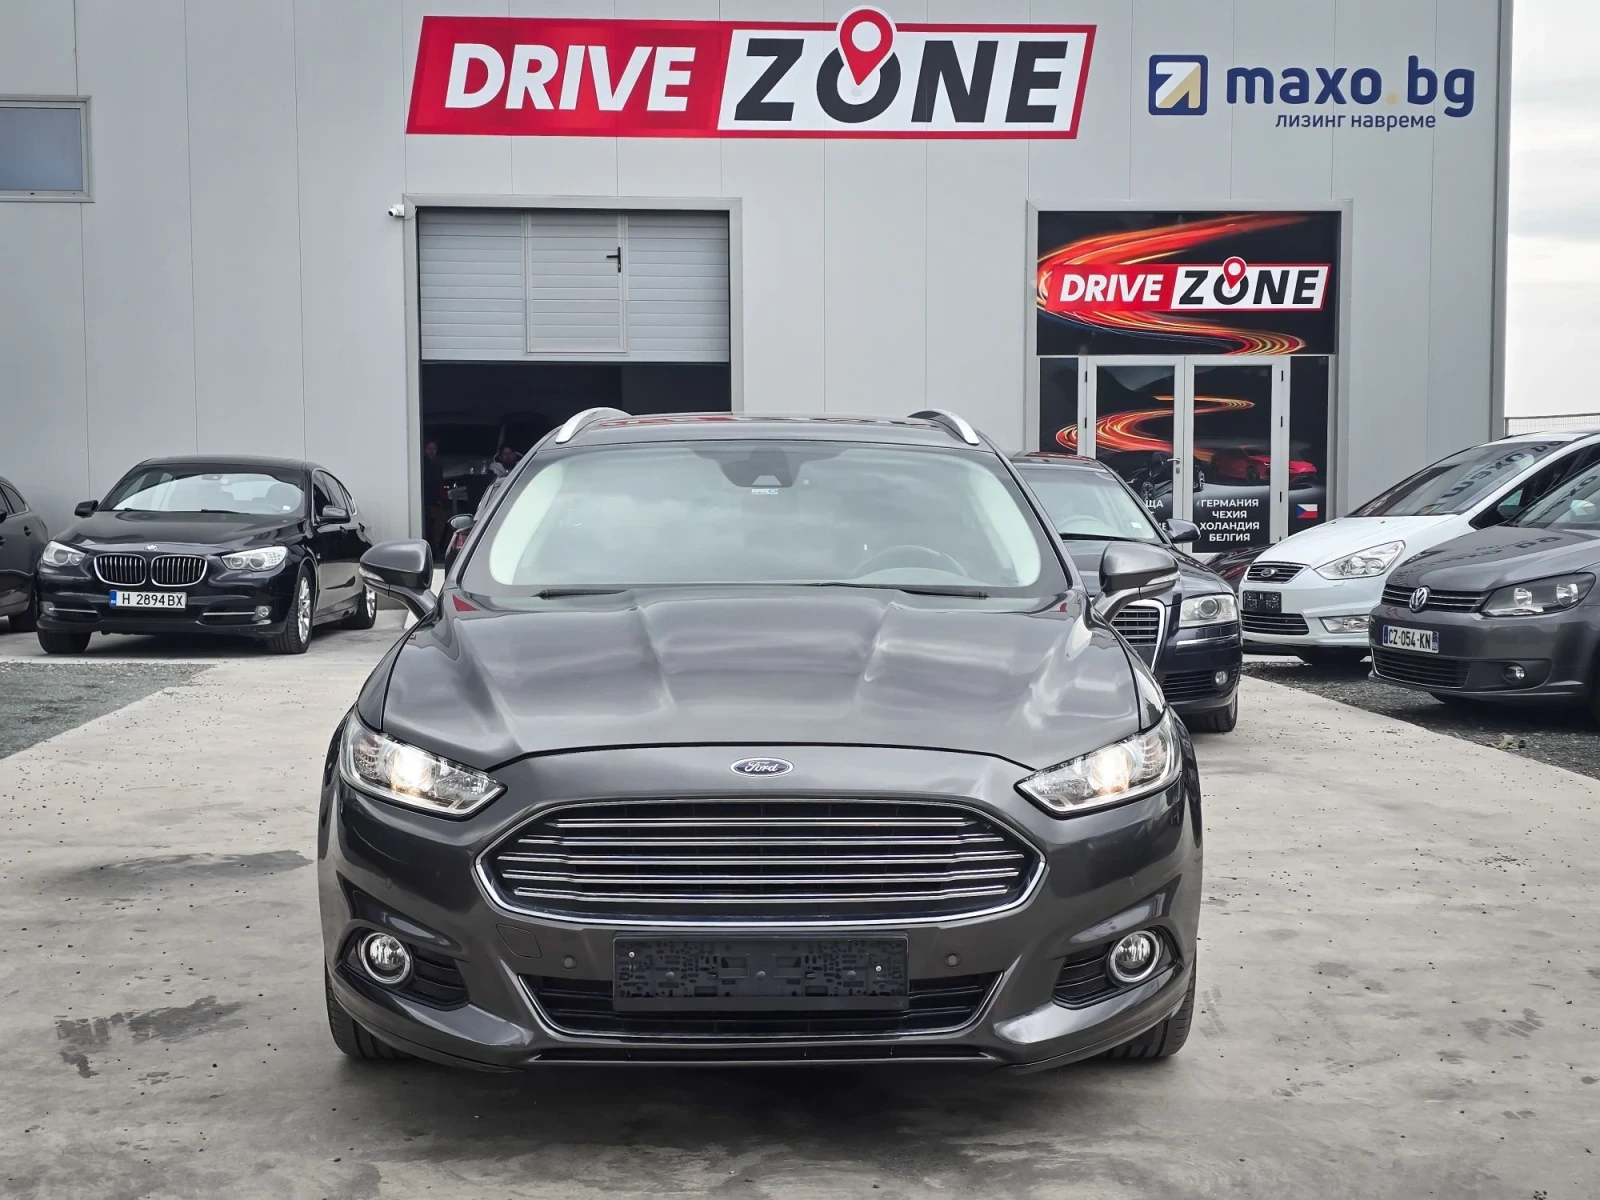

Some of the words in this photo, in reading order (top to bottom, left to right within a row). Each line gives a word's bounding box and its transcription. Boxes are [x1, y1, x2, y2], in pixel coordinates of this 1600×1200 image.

[444, 42, 697, 112] DRIVE
[733, 37, 1069, 124] ZONE
[1226, 55, 1475, 118] maxo.bg
[1275, 113, 1346, 129] лизинг
[1350, 113, 1437, 132] навреме
[1060, 273, 1164, 302] DRIVE
[1178, 269, 1320, 306] ZONE
[1201, 498, 1259, 508] ГЕРМАНИЯ
[1212, 510, 1247, 519] ЧЕХИЯ
[1199, 521, 1260, 532] ХОЛАНДИЯ
[1209, 533, 1251, 542] БЕЛГИЯ
[744, 761, 779, 772] Ford
